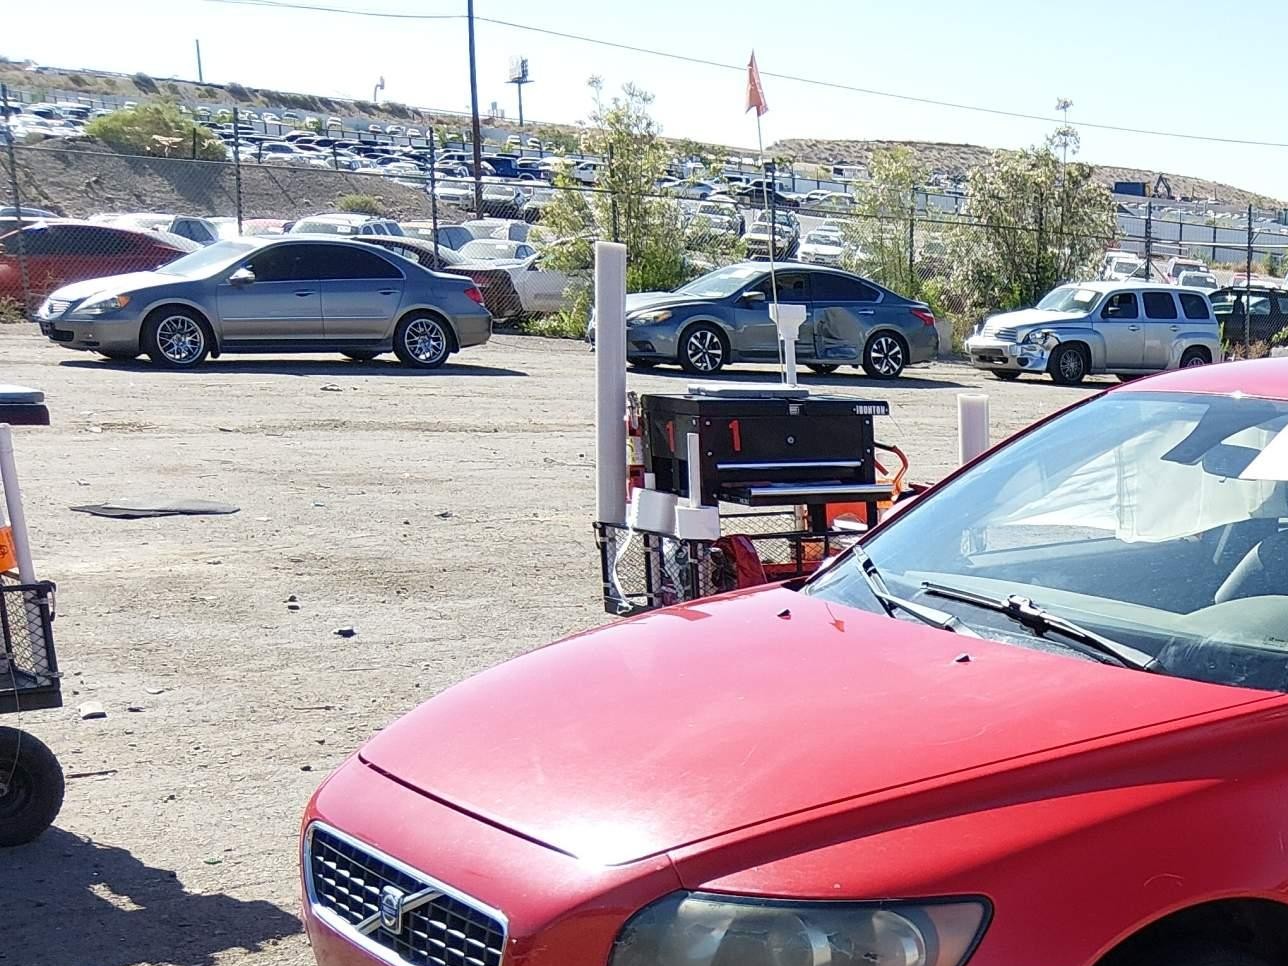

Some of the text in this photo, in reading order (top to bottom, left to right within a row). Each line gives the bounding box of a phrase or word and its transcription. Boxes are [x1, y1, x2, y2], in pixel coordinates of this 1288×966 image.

[856, 405, 886, 415] IRONTON
[664, 419, 675, 452] 1
[728, 419, 742, 452] 1
